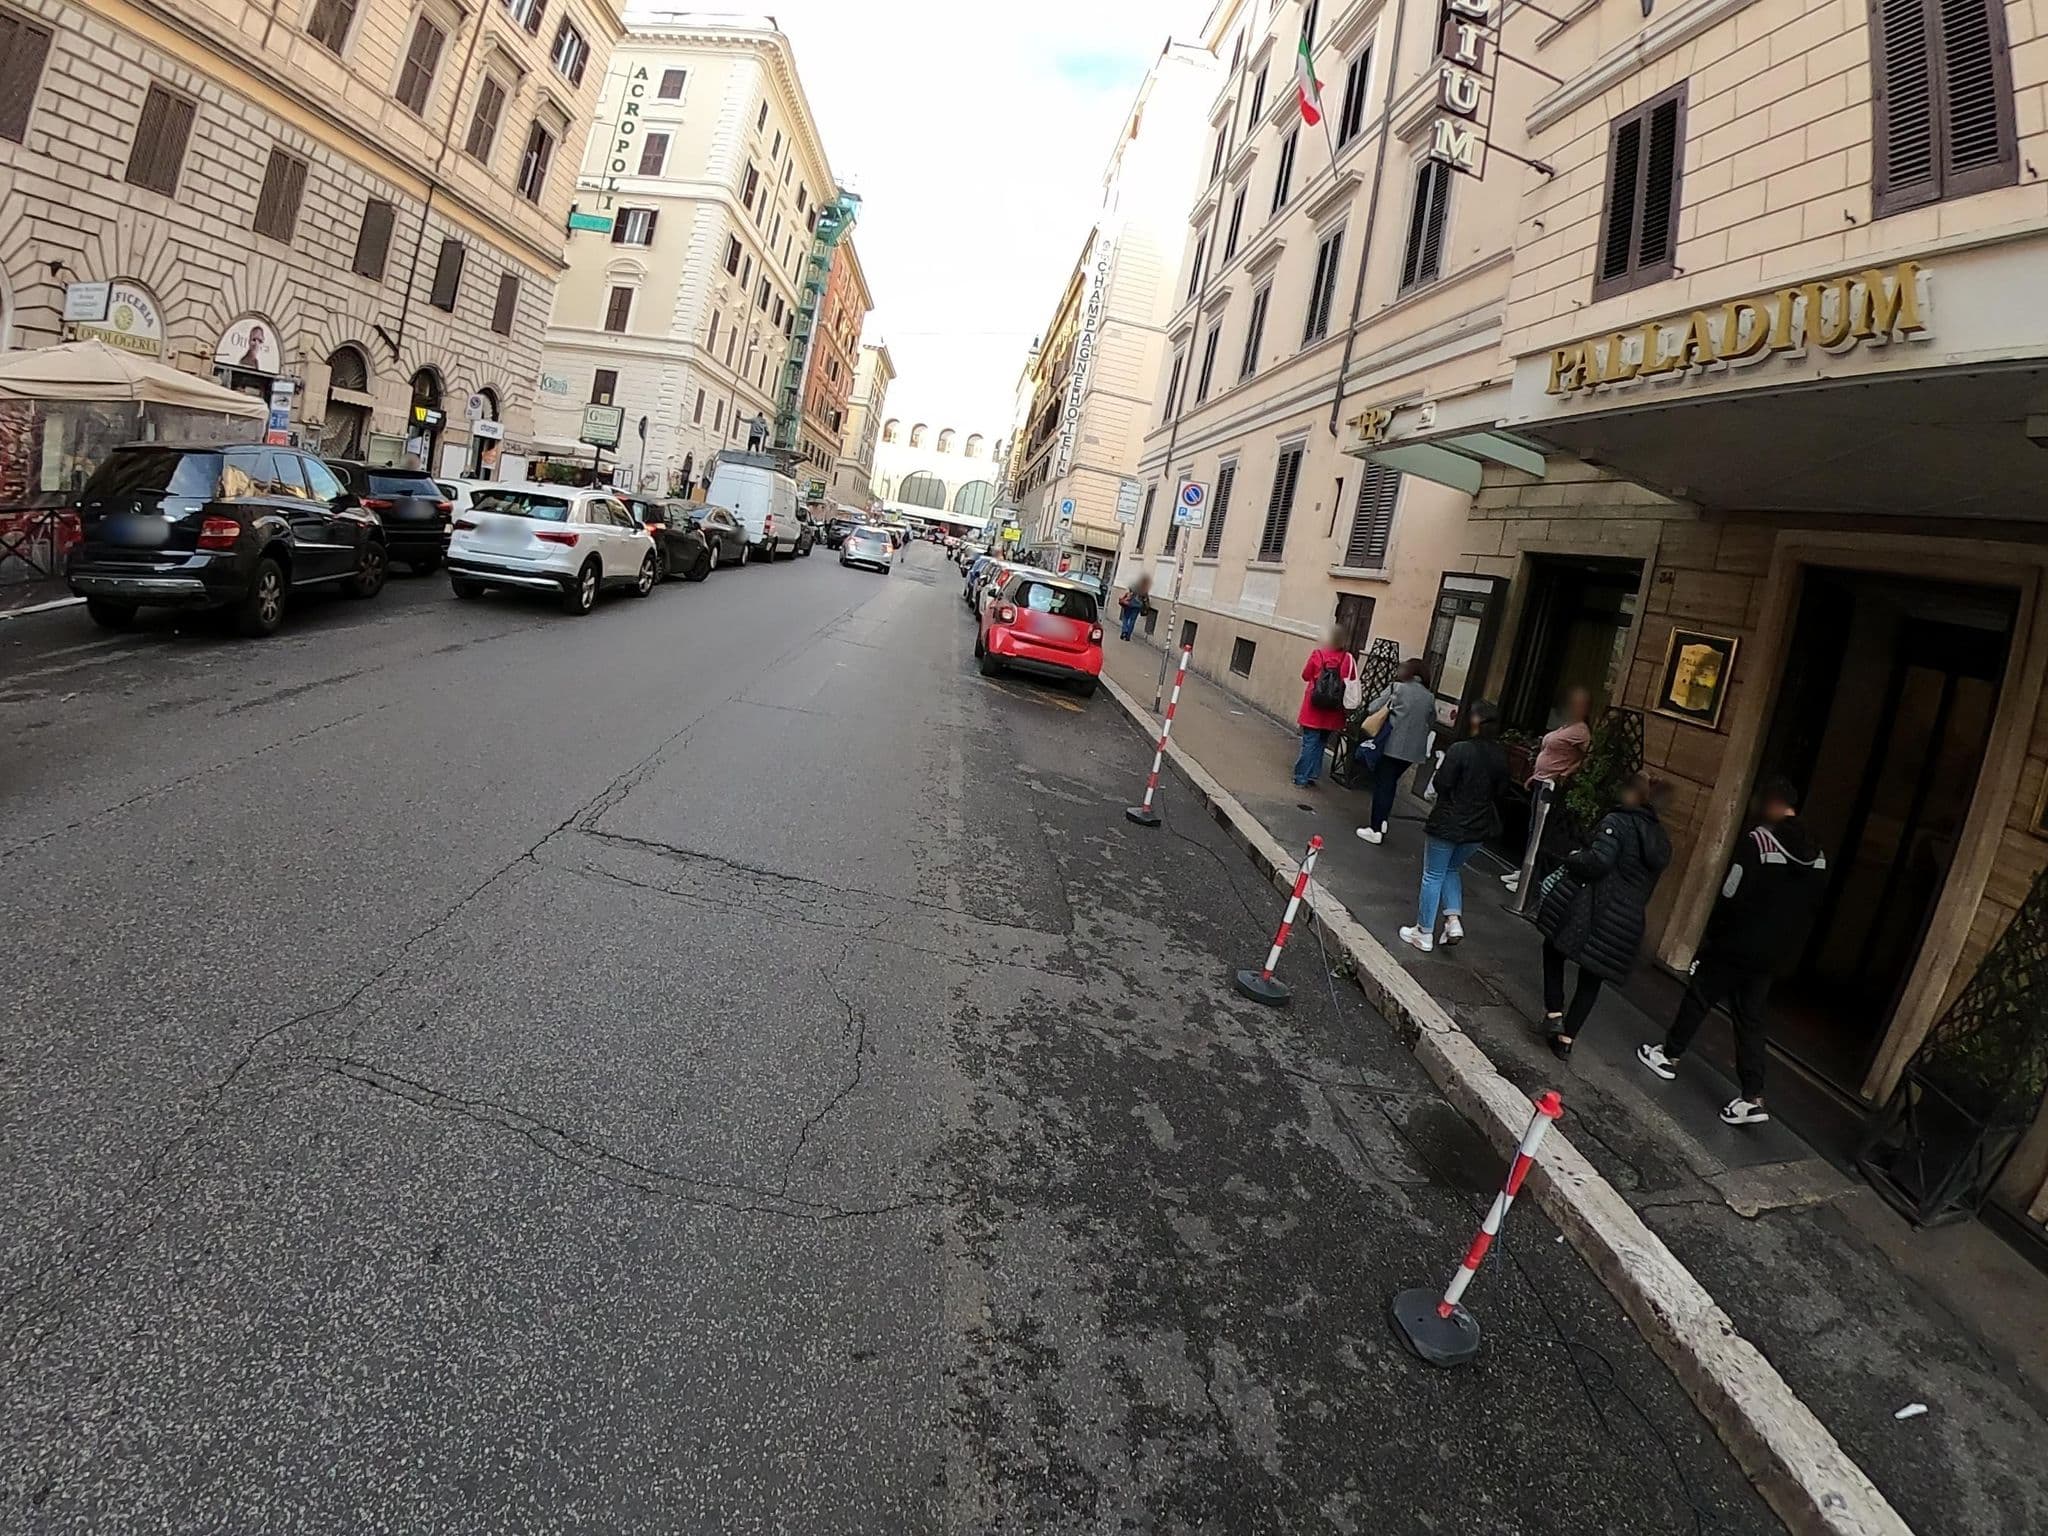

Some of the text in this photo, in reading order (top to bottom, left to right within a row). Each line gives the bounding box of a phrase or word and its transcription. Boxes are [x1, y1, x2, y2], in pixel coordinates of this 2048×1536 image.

[603, 66, 649, 211] ACROPOLI
[1059, 261, 1108, 462] CHAMPAGNE HOTEL
[1544, 262, 1934, 399] PALLADIUM
